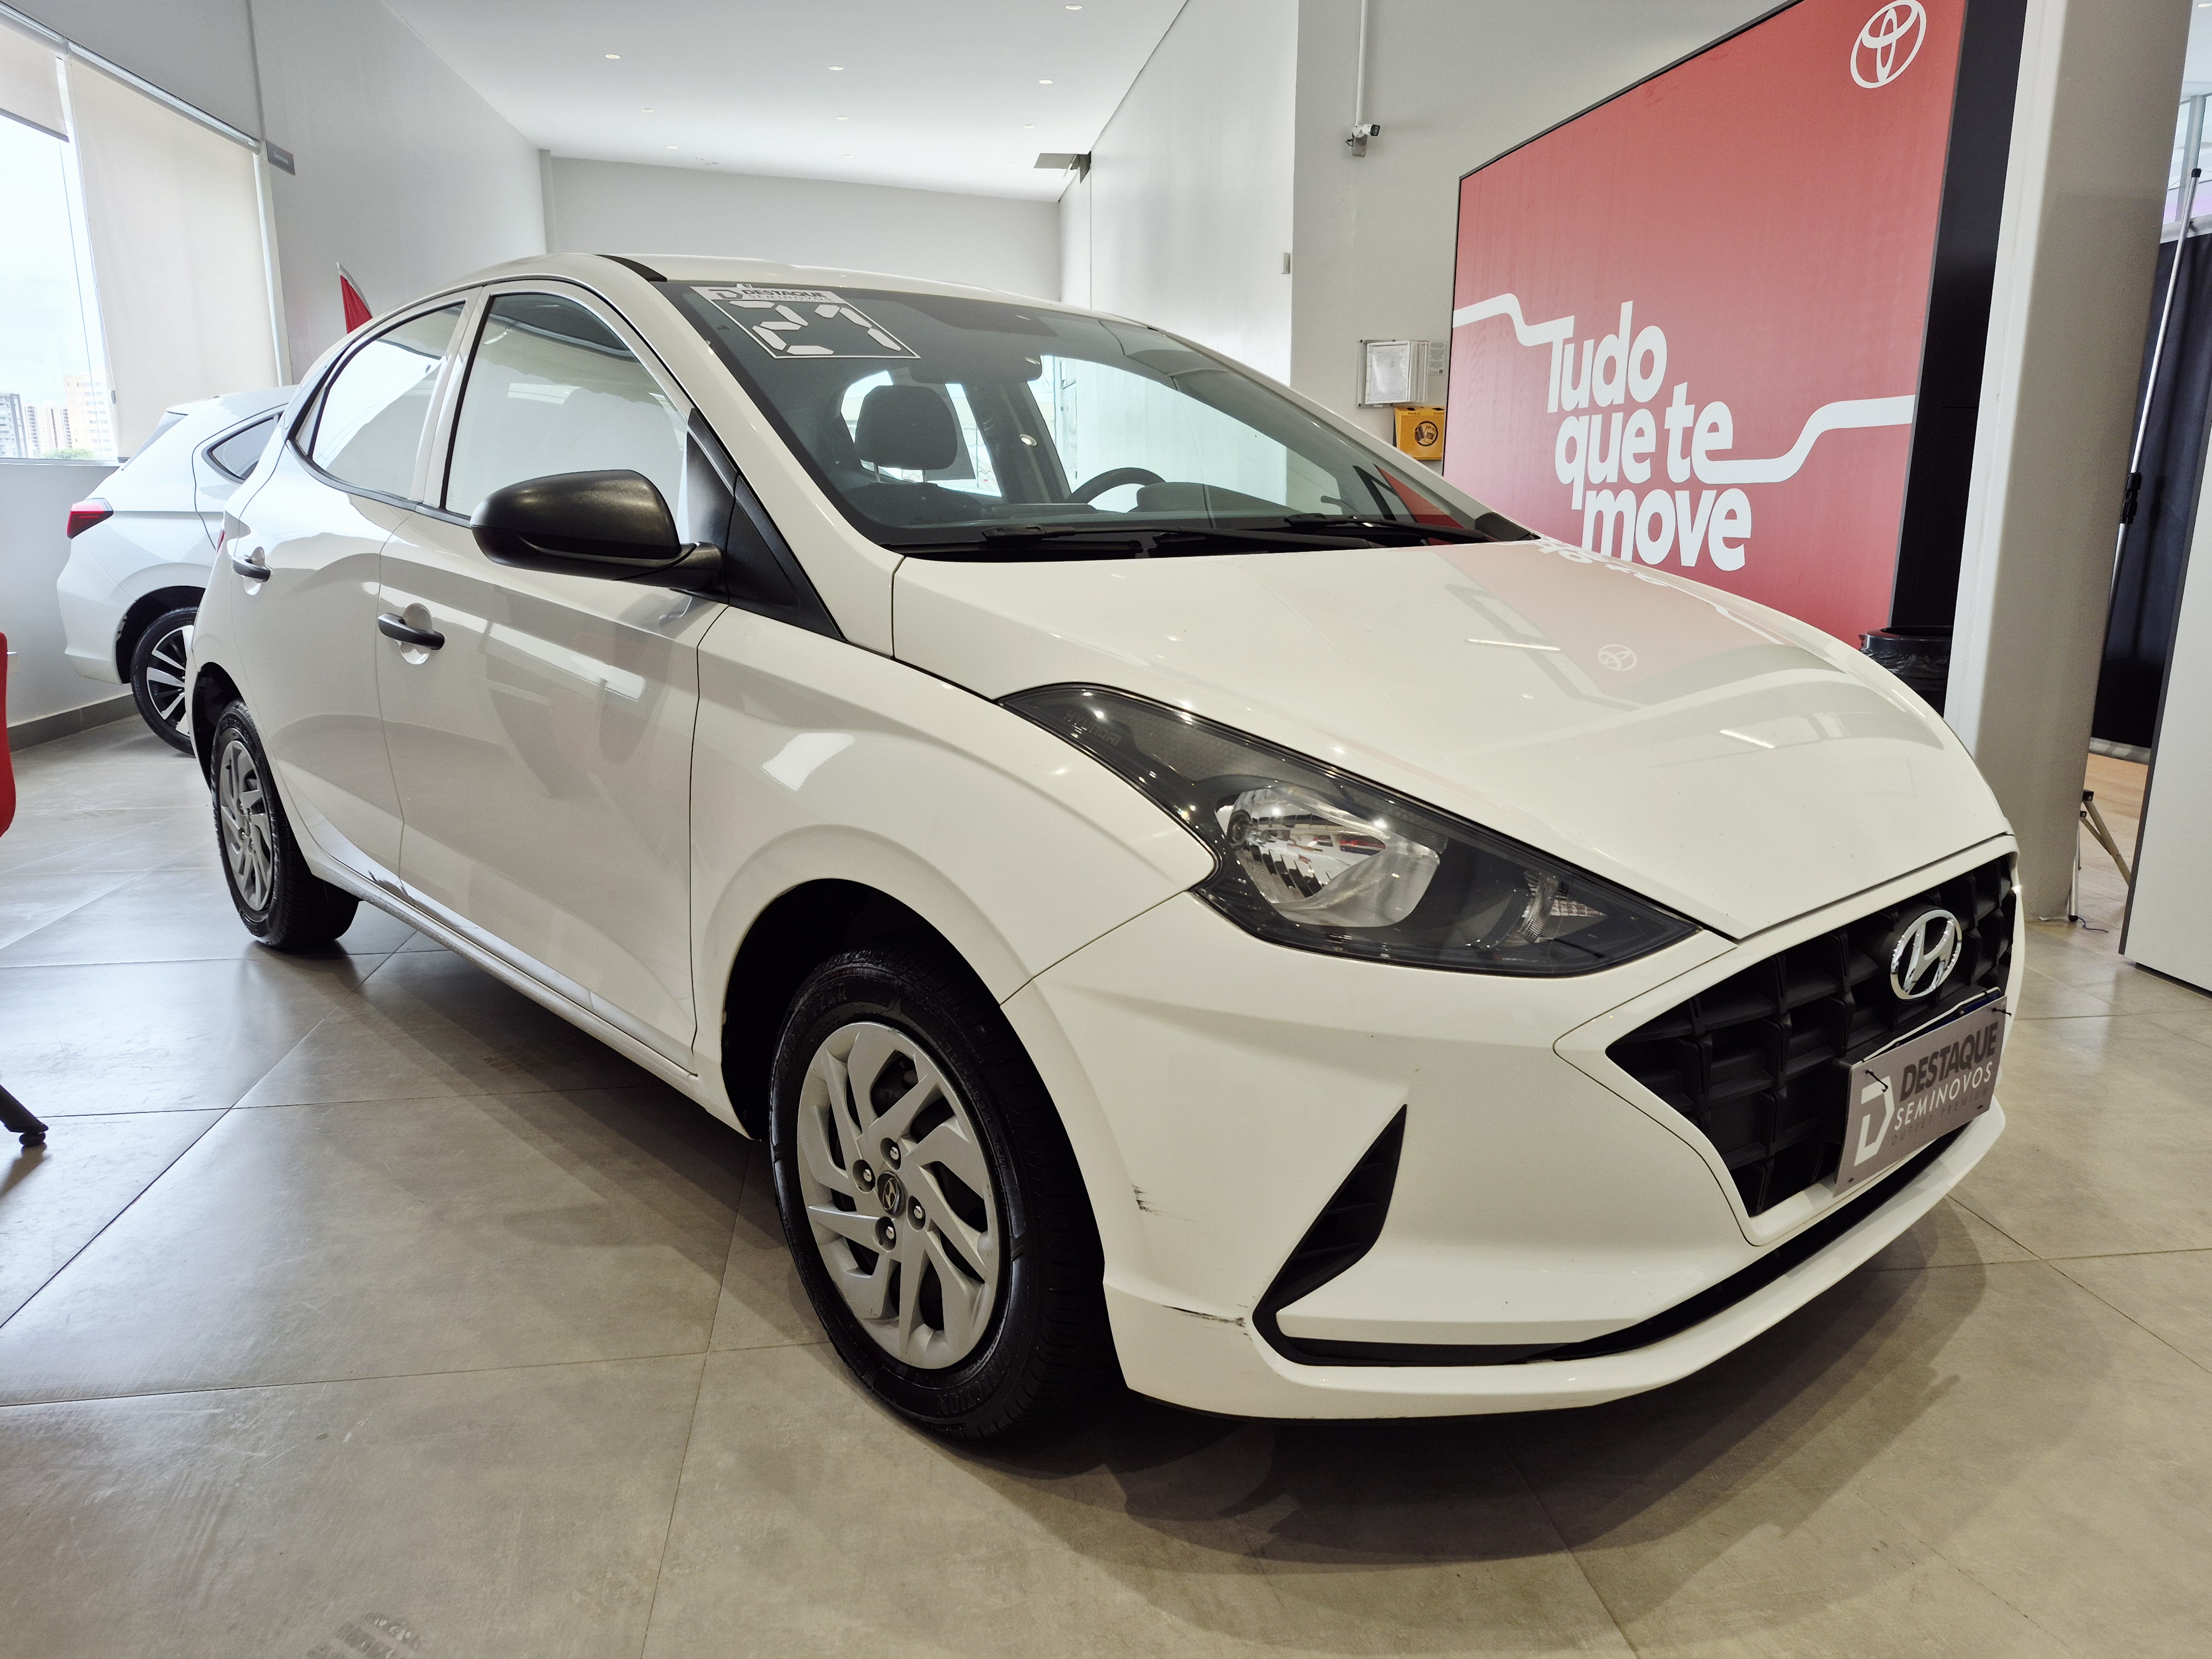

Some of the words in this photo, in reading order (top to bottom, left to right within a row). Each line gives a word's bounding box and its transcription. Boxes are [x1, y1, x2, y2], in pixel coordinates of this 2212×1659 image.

[740, 289, 827, 298] DESTAQUE
[1531, 300, 1667, 413] Tudo
[1554, 408, 1656, 510] que
[1581, 488, 1751, 571] move
[1894, 1061, 1993, 1131] SEMINOVOS
[1899, 1021, 1999, 1102] DESTAQUE
